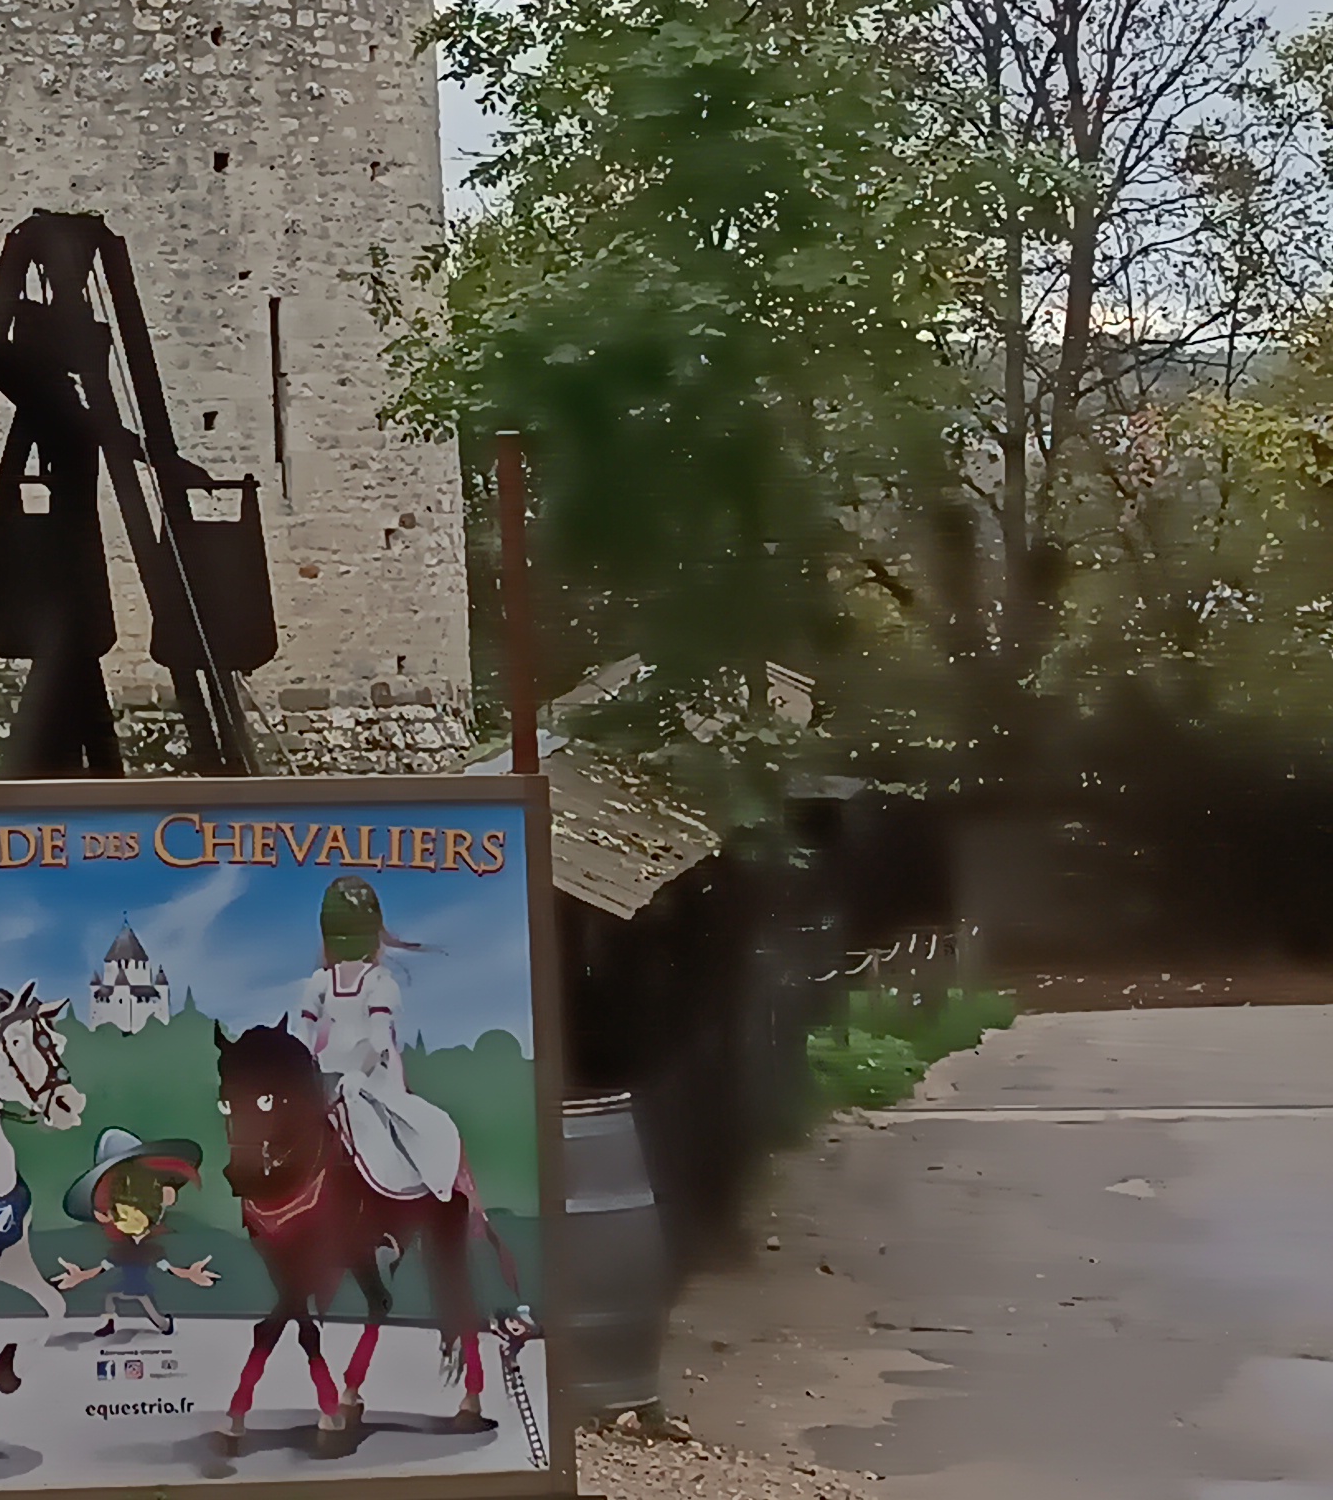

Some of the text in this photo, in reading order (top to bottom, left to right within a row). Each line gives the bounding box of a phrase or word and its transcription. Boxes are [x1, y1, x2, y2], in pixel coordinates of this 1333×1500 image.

[81, 832, 141, 861] DES
[154, 812, 506, 876] CHEVALIERS
[85, 1397, 195, 1420] equestrio.fr
